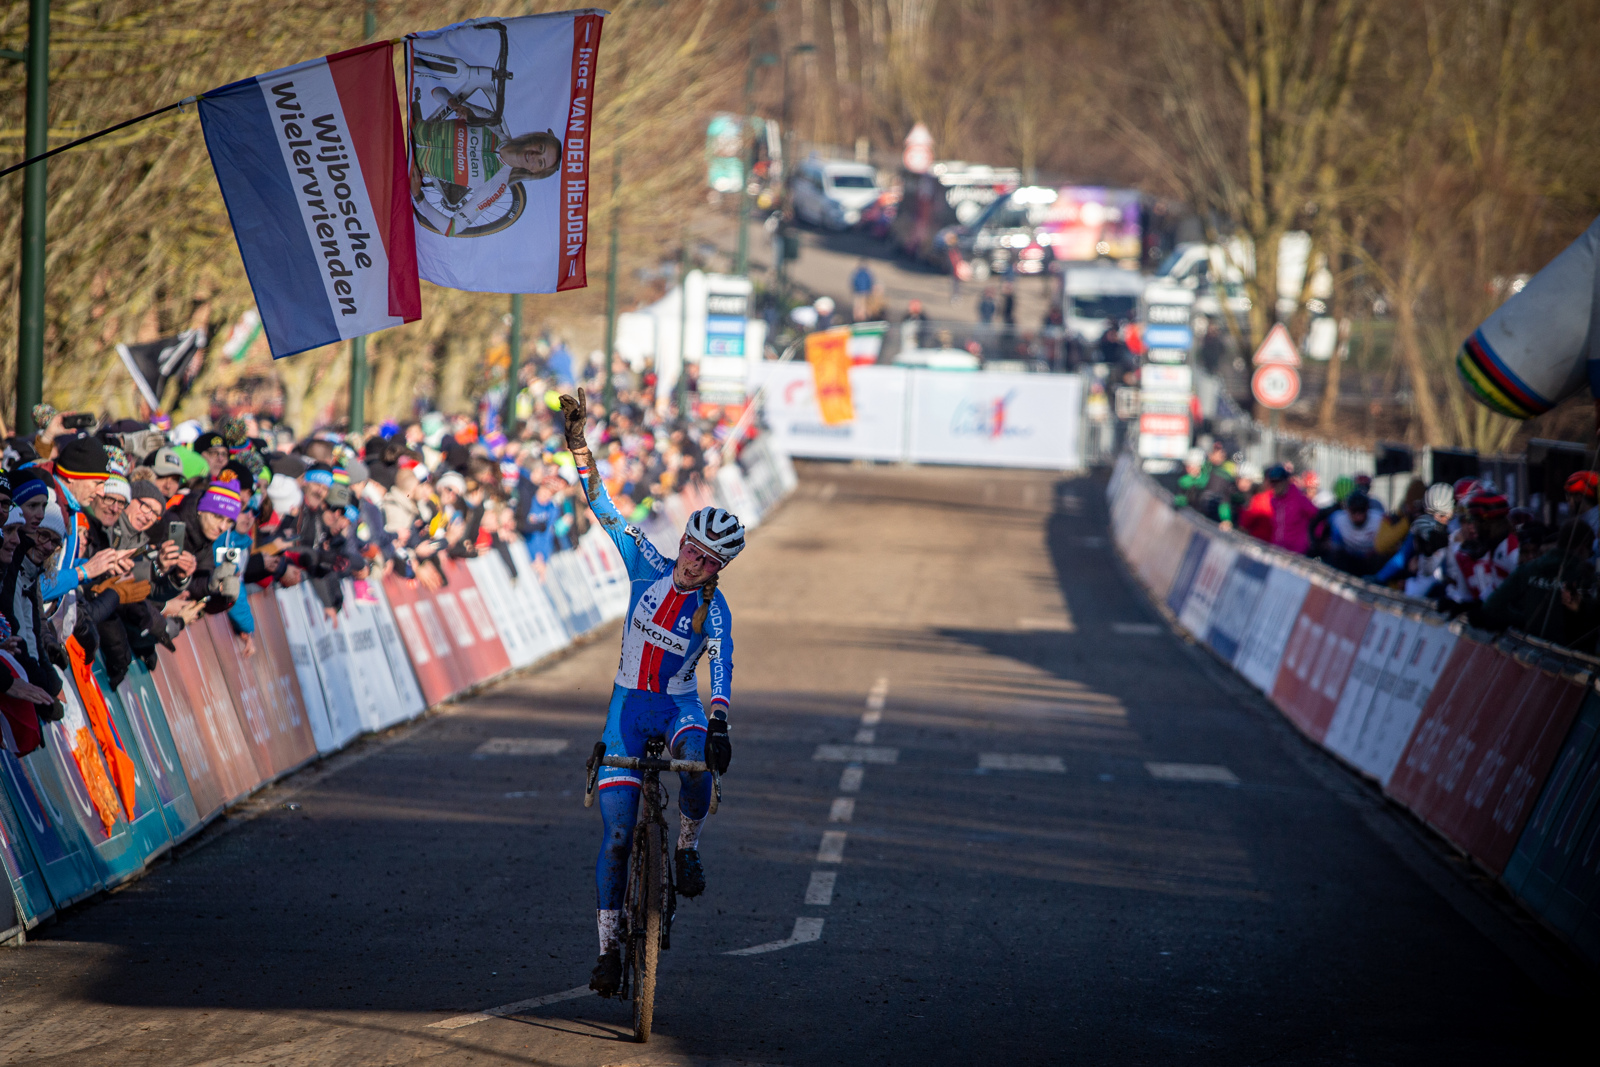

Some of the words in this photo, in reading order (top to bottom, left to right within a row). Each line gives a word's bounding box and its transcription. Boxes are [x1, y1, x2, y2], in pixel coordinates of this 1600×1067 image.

[569, 97, 587, 132] VAN
[457, 128, 465, 171] corendon
[469, 135, 479, 178] Crelan
[567, 138, 584, 173] DER
[270, 81, 358, 317] Wielervrienden
[311, 113, 373, 269] Wijbosche
[478, 183, 507, 210] corendon
[566, 180, 586, 256] HEIJDEN
[708, 597, 724, 638] KODA
[707, 644, 718, 656] 6
